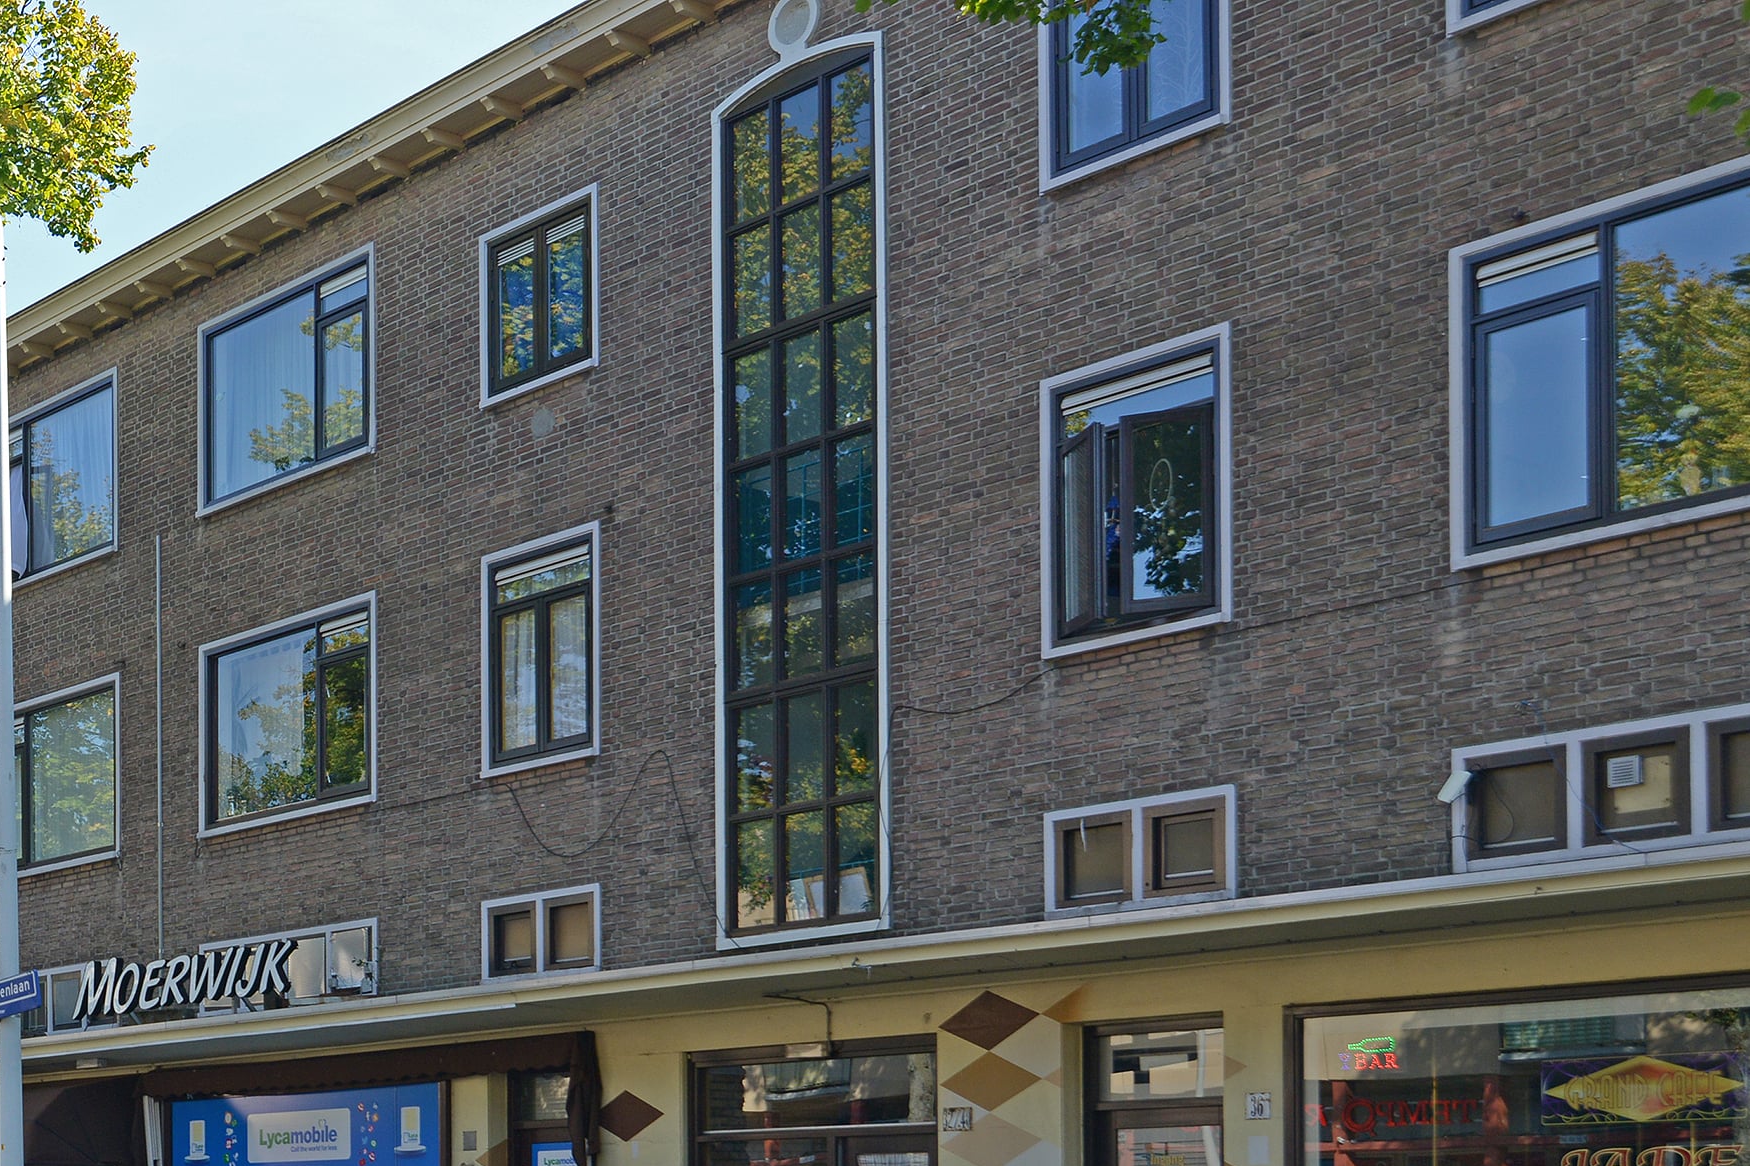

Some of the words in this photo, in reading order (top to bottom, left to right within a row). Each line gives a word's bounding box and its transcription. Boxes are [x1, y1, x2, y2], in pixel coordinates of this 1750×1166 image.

[72, 938, 294, 1021] MOERWIJK
[1354, 1053, 1399, 1070] BAR
[1564, 1073, 1649, 1111] GRAND
[1656, 1069, 1723, 1106] CAFE
[259, 1125, 338, 1149] Lycamobile
